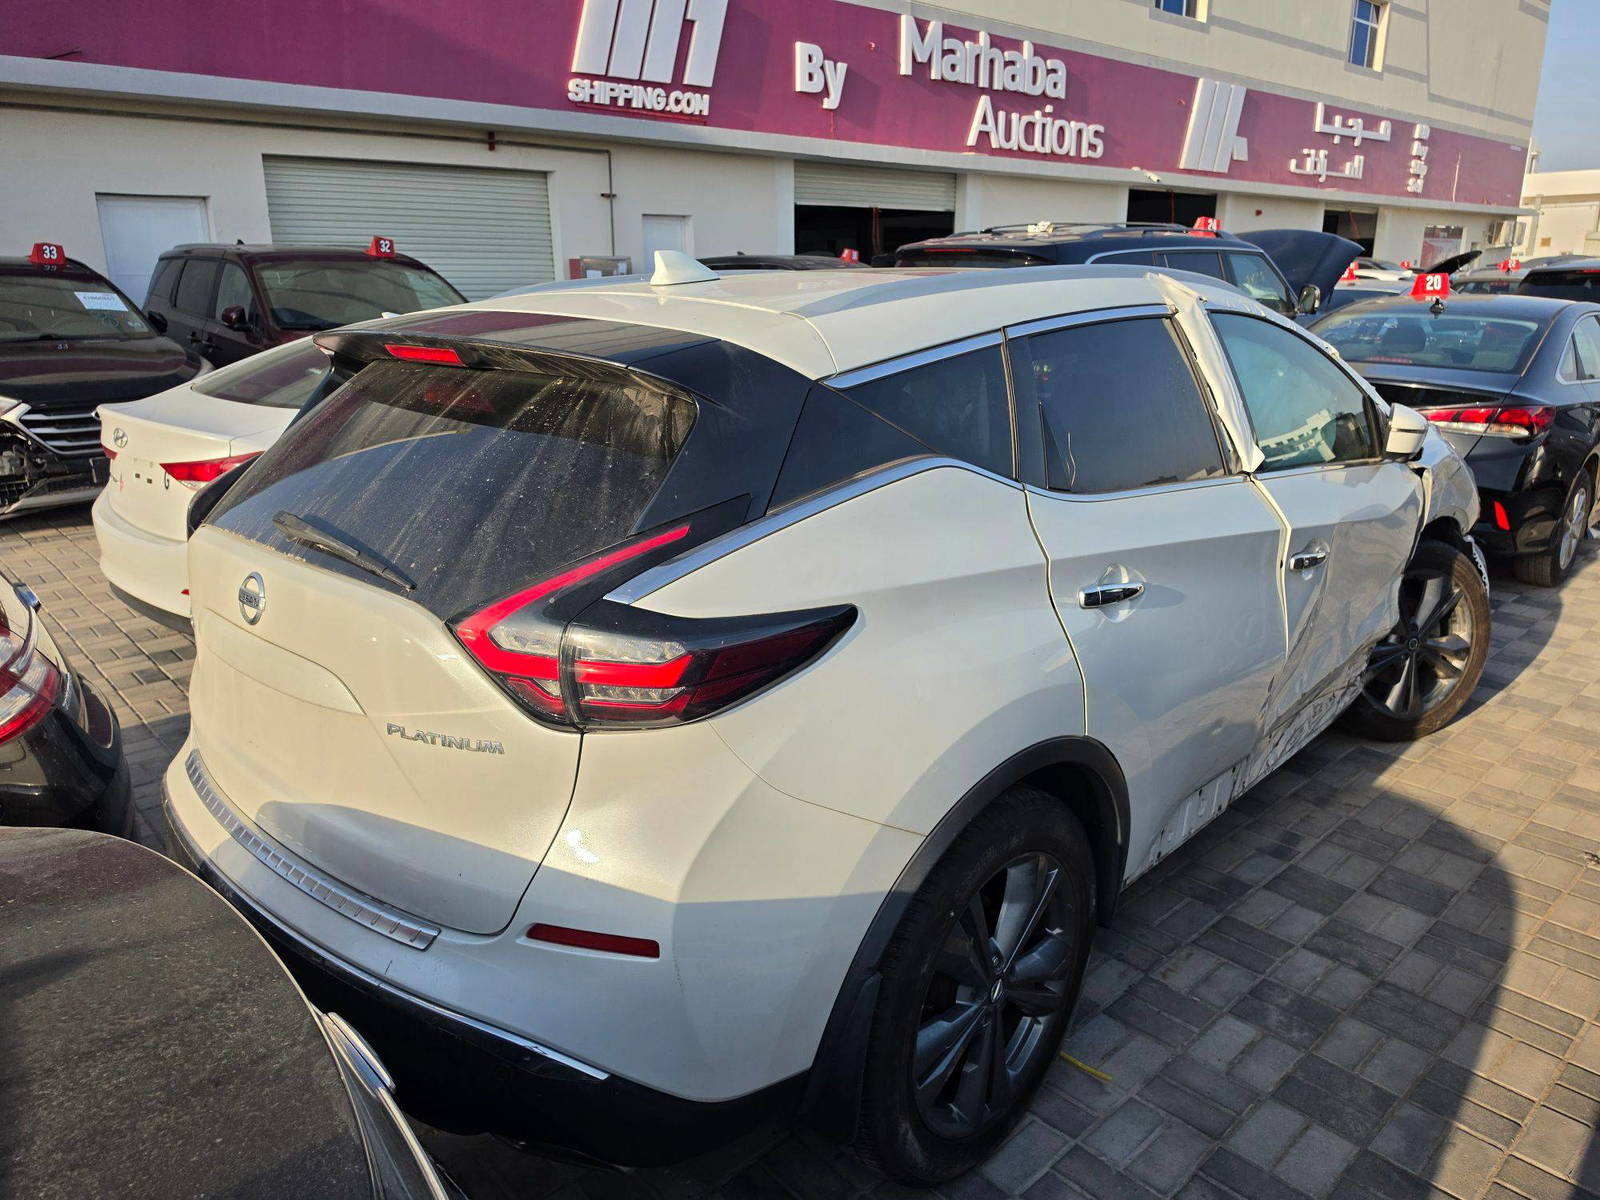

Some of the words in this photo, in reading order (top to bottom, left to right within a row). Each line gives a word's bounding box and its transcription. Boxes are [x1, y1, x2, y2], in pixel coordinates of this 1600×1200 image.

[898, 13, 1067, 100] Marhaba
[794, 40, 848, 110] By
[567, 78, 710, 116] SHIPPING.COM
[966, 94, 1105, 159] Auctions
[42, 245, 57, 259] 33
[379, 239, 391, 253] 32
[1426, 274, 1442, 291] 20
[386, 722, 505, 755] PLATINUM
